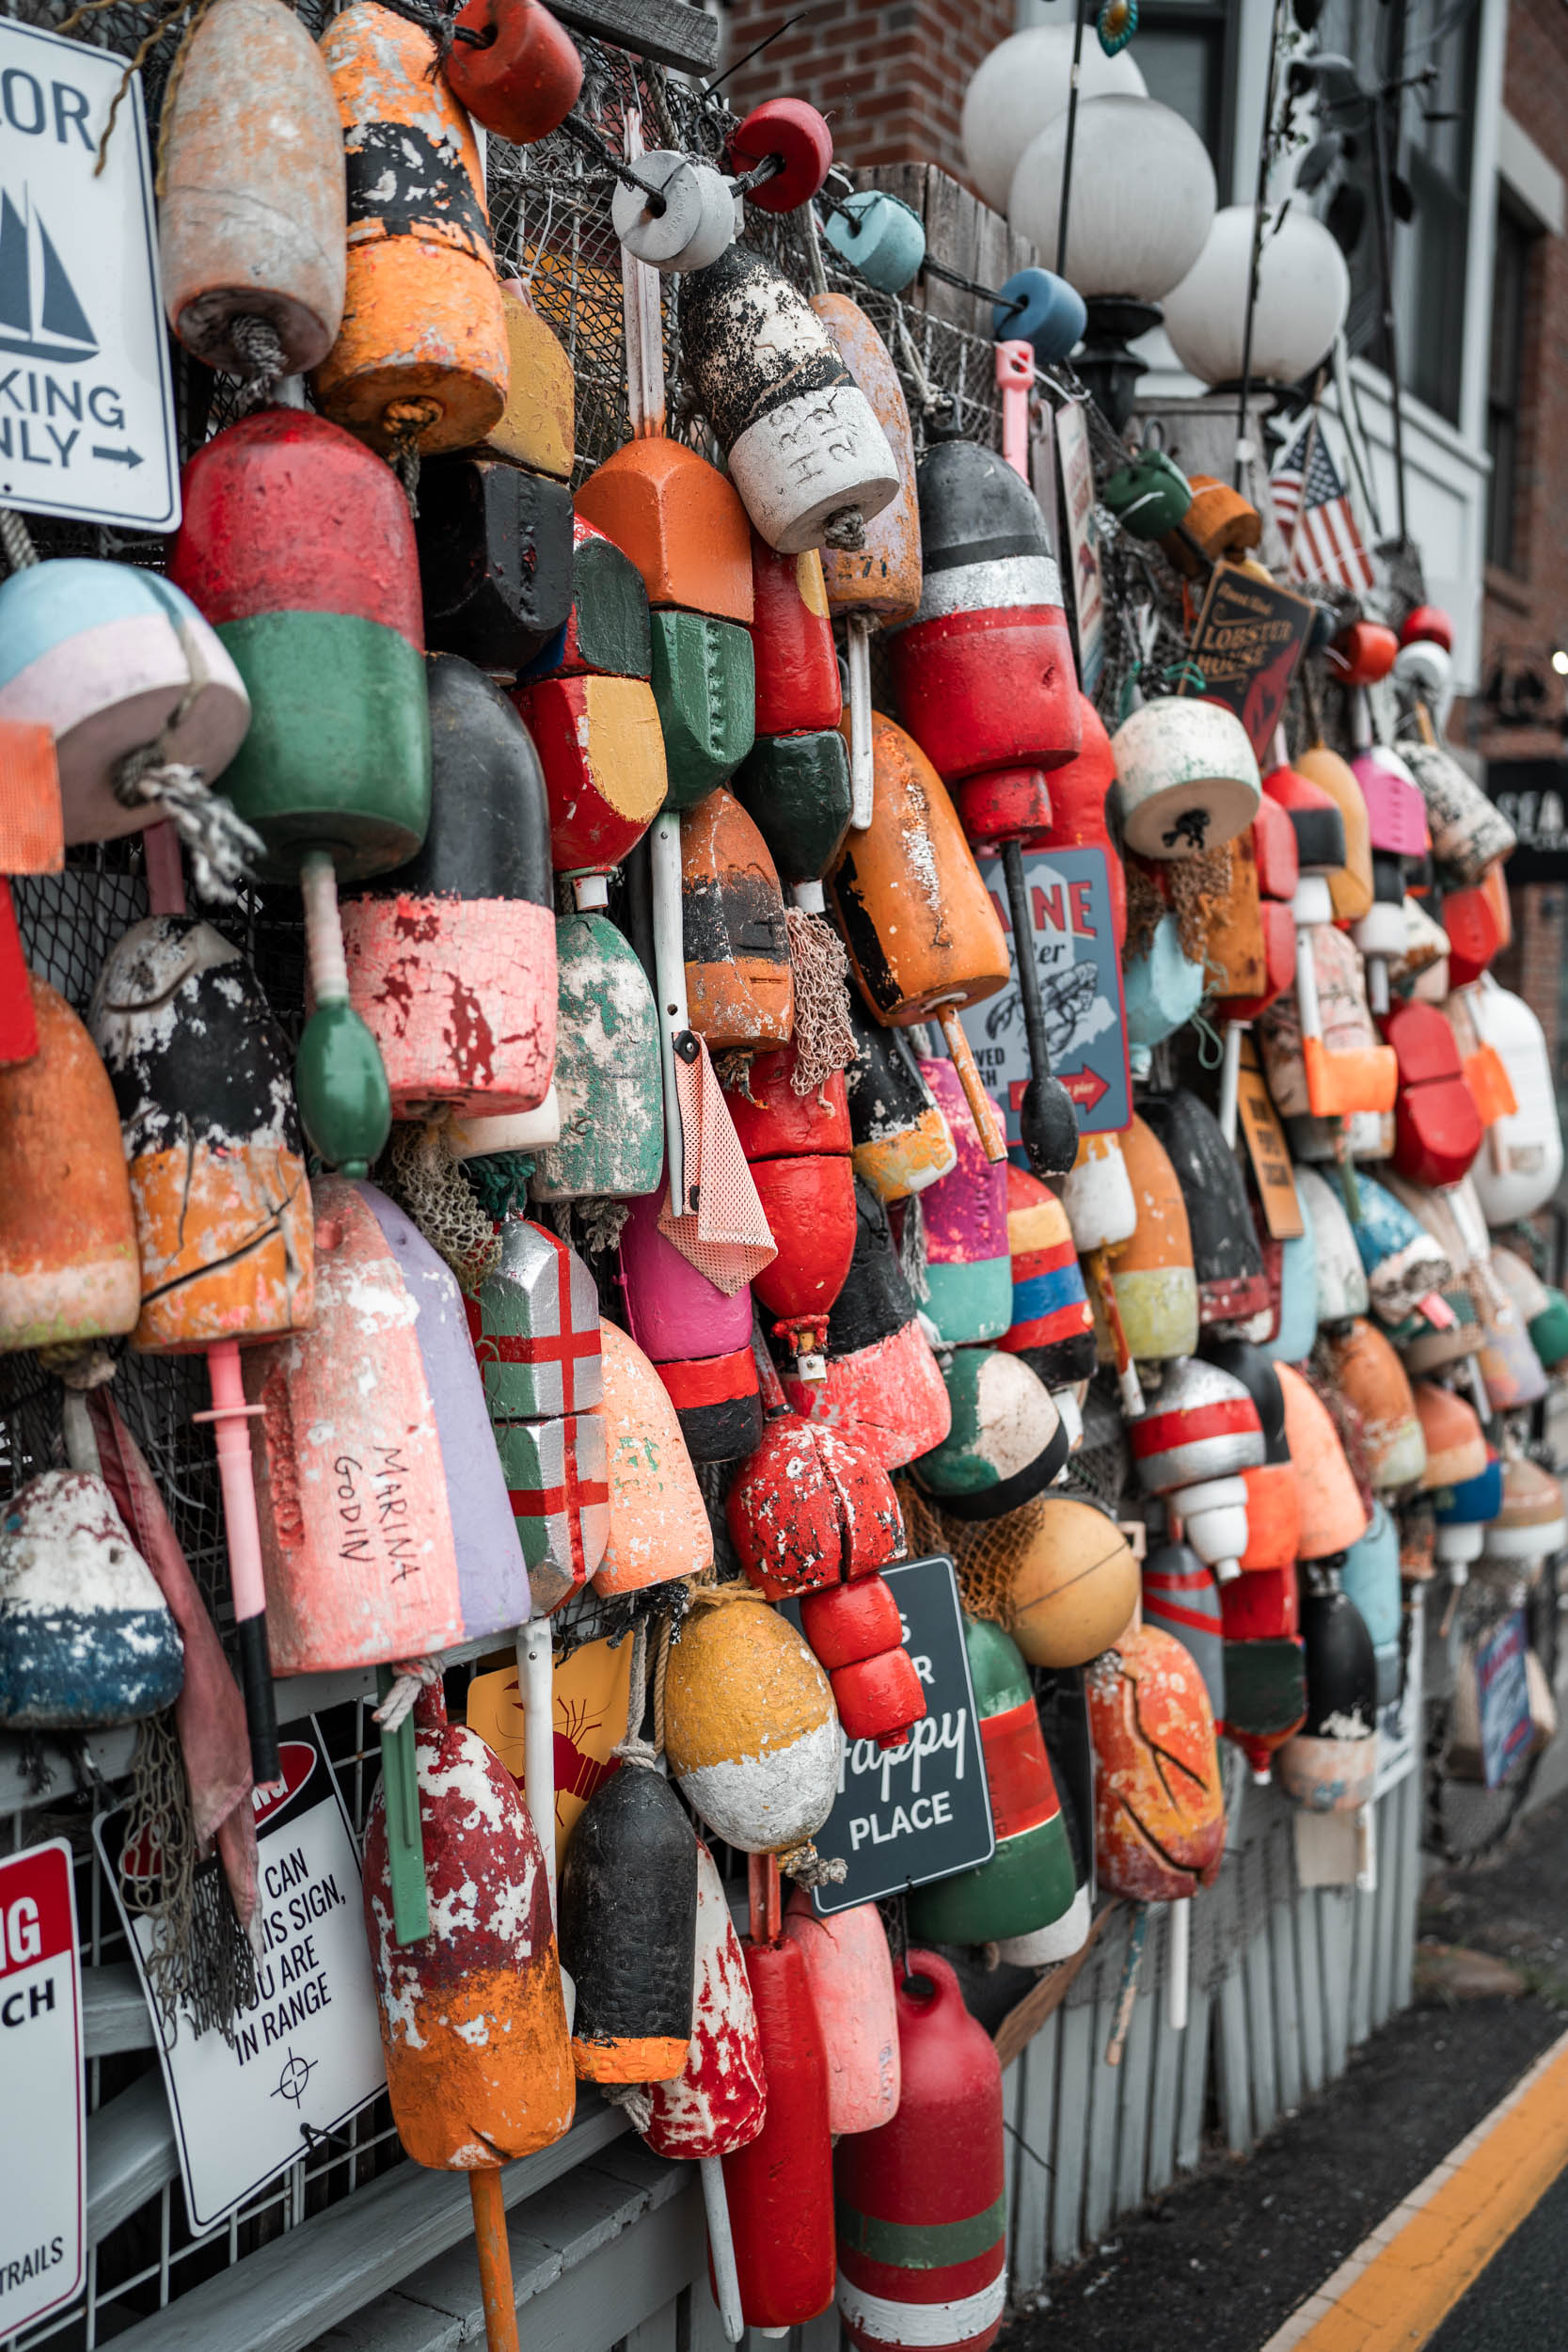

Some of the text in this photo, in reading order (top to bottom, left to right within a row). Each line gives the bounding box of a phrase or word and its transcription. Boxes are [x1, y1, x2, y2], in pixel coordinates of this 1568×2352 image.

[0, 68, 96, 152] OR
[1196, 644, 1267, 676] HOUSE
[1202, 619, 1292, 650] LOBSTER
[973, 1047, 1006, 1067] VED
[334, 1456, 375, 1562] GODIN
[372, 1446, 420, 1584] MARINA
[849, 1790, 954, 1851] PLACE
[264, 1847, 309, 1899] CAN
[289, 1873, 346, 1931] SIGN,
[280, 1934, 320, 1990] ARE
[234, 1971, 332, 2067] IN RANGE
[0, 2235, 64, 2296] TRAILS
